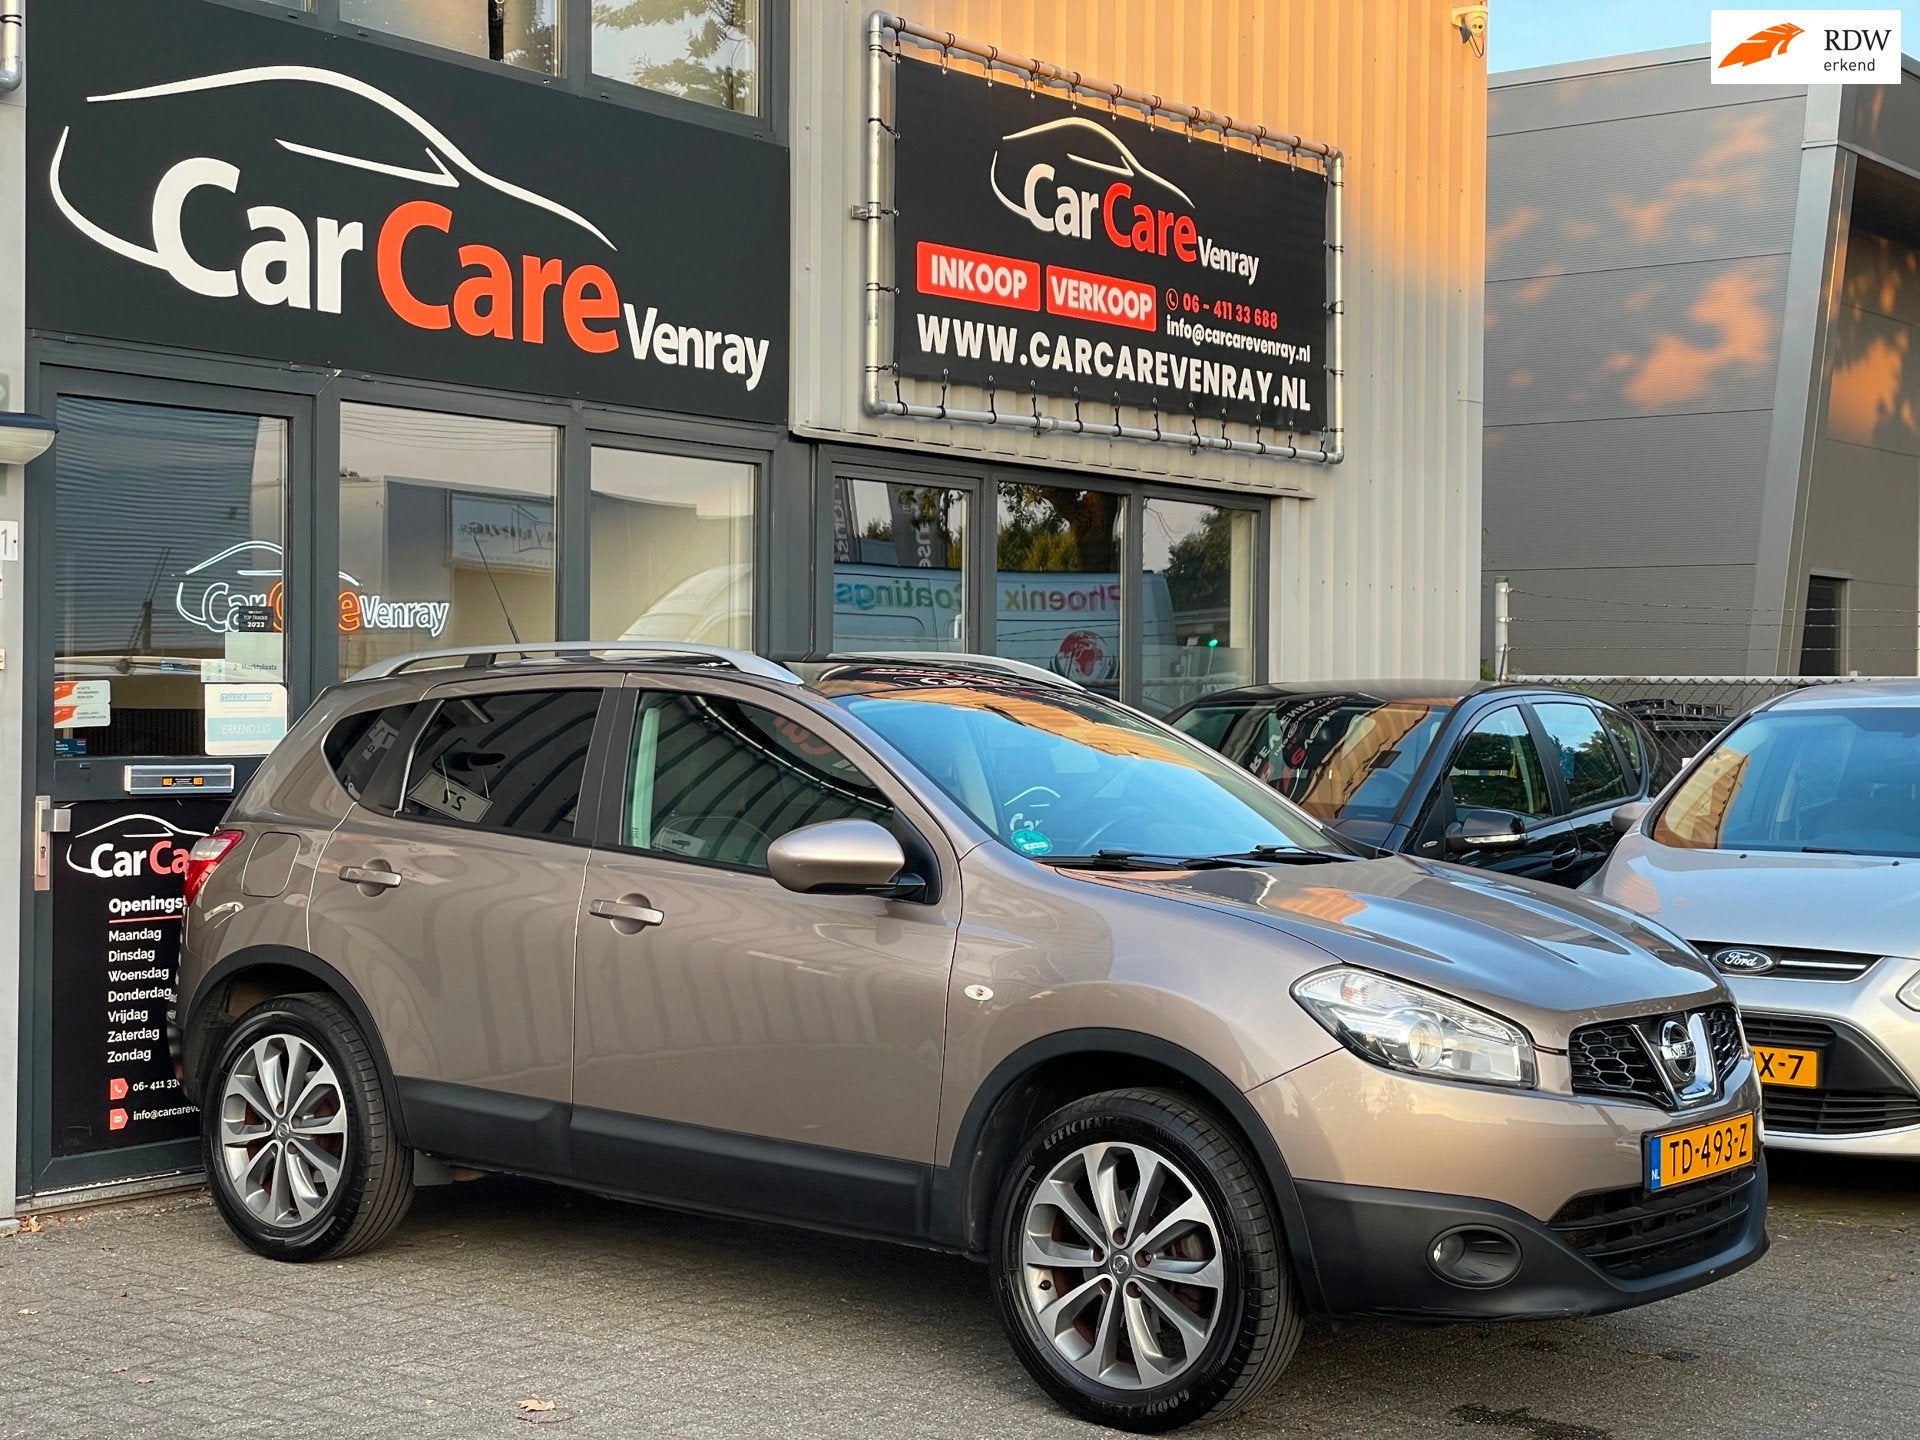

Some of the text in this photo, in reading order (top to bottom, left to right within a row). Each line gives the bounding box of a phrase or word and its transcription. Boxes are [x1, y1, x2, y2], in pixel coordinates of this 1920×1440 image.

[1198, 235, 1260, 287] Venray
[931, 254, 1028, 299] INKOOP
[1050, 275, 1153, 321] VERKOOP
[1183, 292, 1200, 314] 06
[1213, 300, 1233, 321] 411
[1235, 304, 1251, 325] 33
[1254, 308, 1279, 330] 688
[623, 302, 770, 392] Venray
[1166, 314, 1311, 365] info@carcarevenray.nl
[916, 313, 1311, 412] WWW.CARCAREVENRAY.NL
[359, 595, 449, 638] Venray
[108, 927, 162, 942] Maandag
[108, 948, 156, 963] Dinsdag
[1724, 951, 1759, 967] Ford
[107, 966, 170, 983] Woensdag
[107, 986, 172, 1003] Donderdag
[107, 1008, 149, 1024] Vrijdag
[106, 1027, 160, 1043] Zaterdag
[106, 1048, 152, 1063] Zondag
[1753, 1051, 1804, 1080] X-7
[1669, 1122, 1748, 1177] TD-493-Z
[1651, 1168, 1660, 1181] NL
